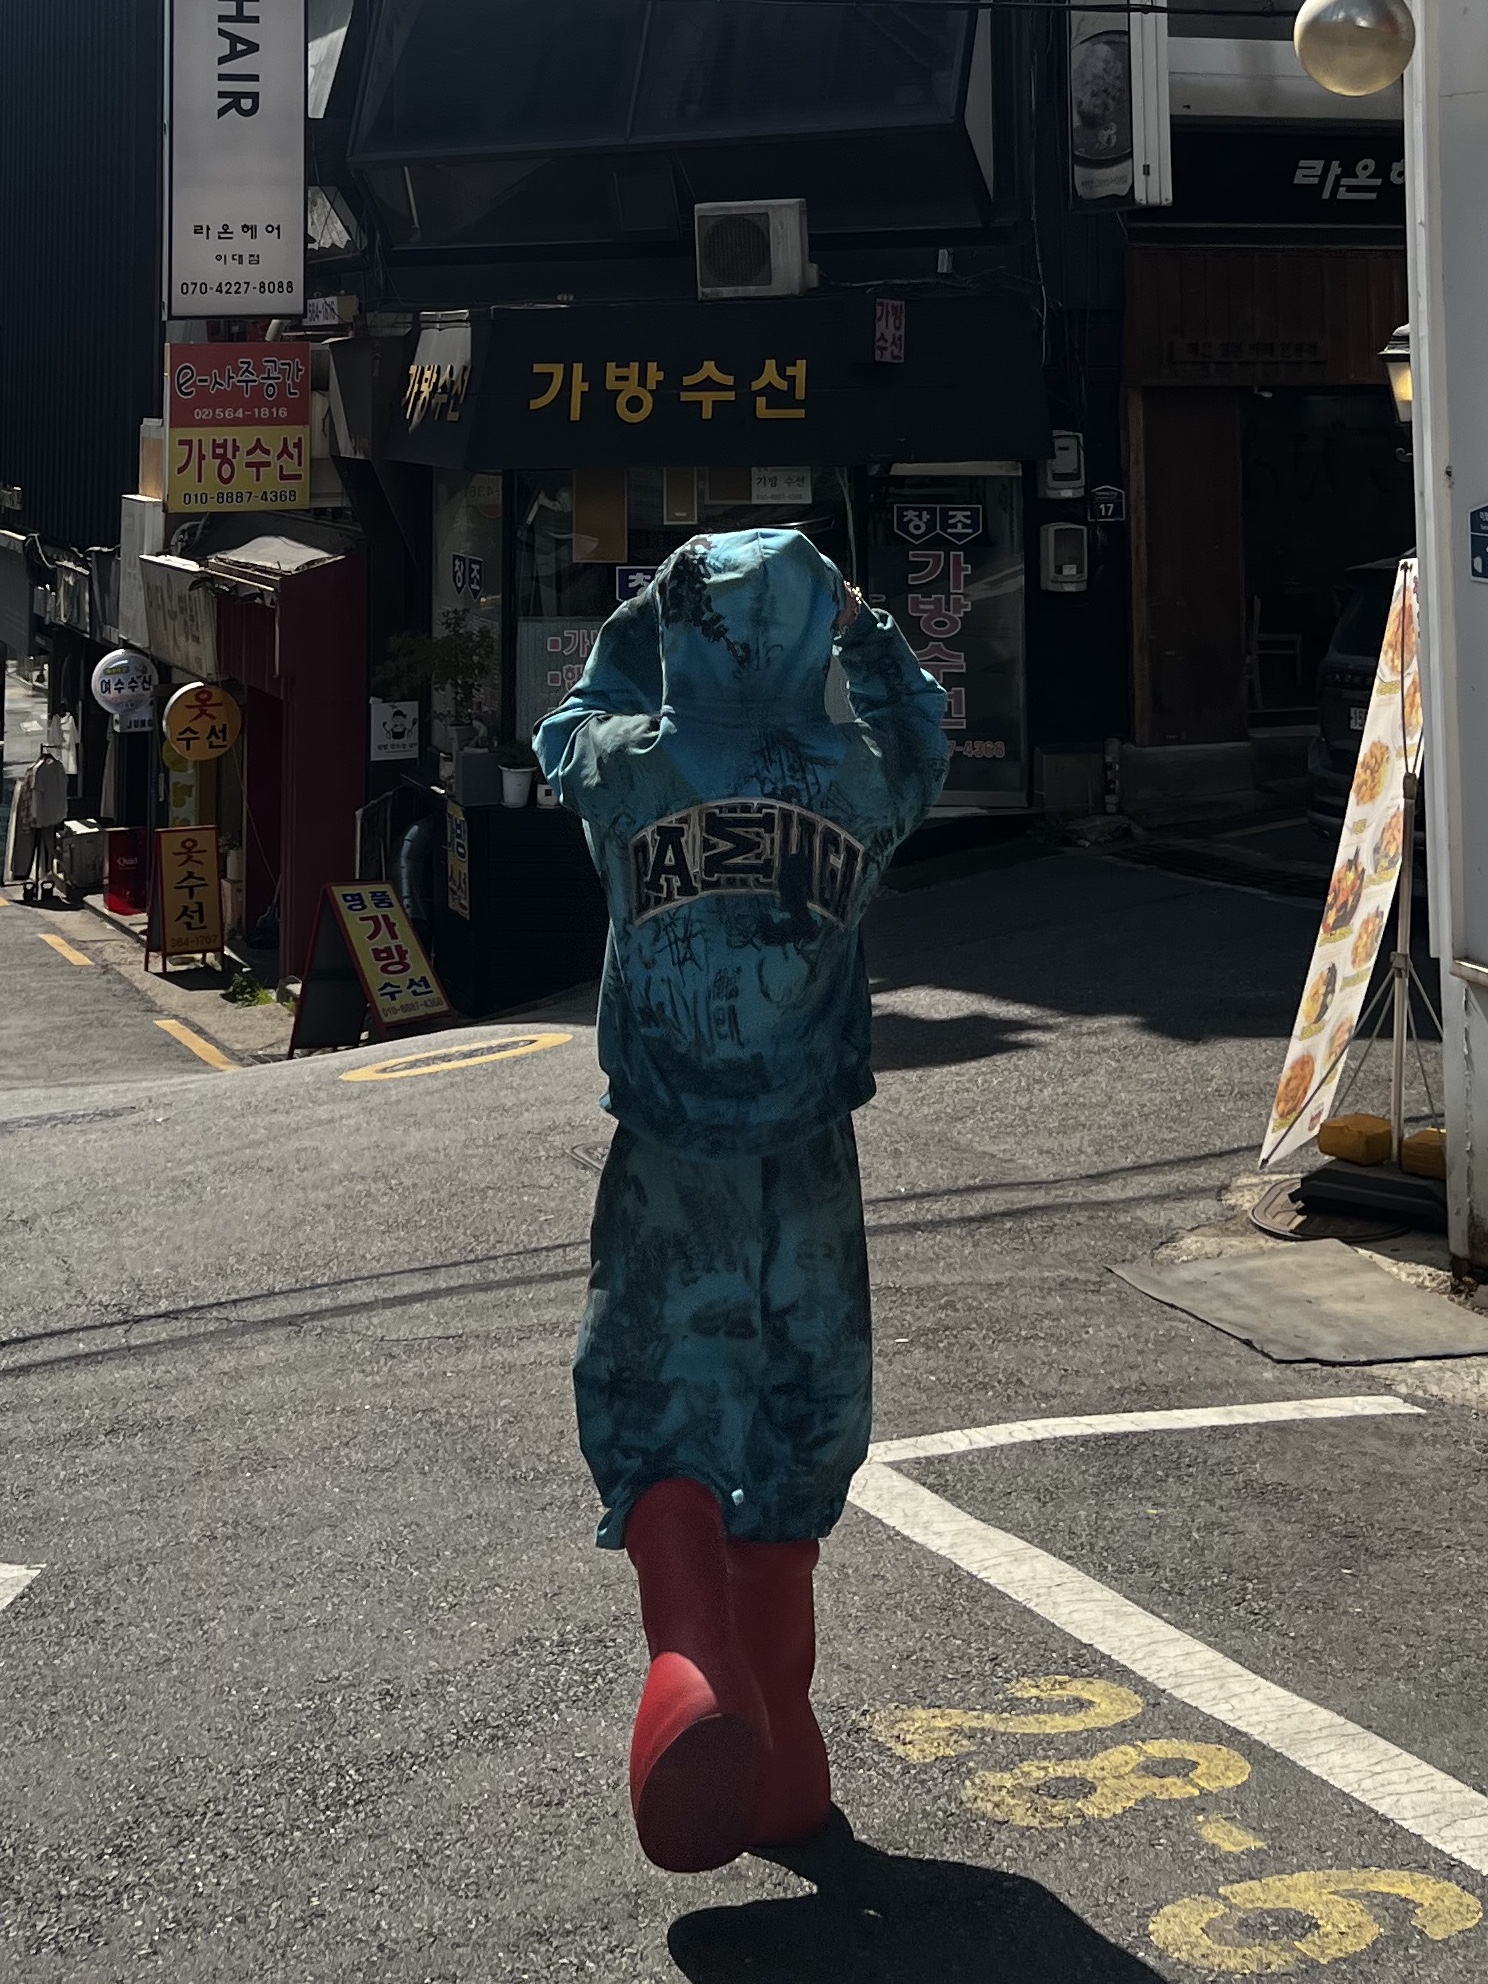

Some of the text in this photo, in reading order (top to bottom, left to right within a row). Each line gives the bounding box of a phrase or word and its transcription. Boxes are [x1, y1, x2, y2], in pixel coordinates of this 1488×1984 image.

[193, 223, 281, 240] 라온헤어
[215, 253, 261, 266] 이대점
[180, 281, 294, 296] 070-4227-8088
[877, 301, 904, 330] 가방
[877, 332, 903, 360] 수선
[401, 363, 470, 434] 가방수선
[528, 358, 808, 424] 가방수선
[176, 436, 305, 485] 가방수선
[183, 490, 297, 505] 010-8887-4368
[1099, 503, 1114, 516] 17
[903, 510, 974, 535] 창조
[185, 688, 223, 722] 옷
[176, 724, 227, 750] 수선
[341, 890, 394, 911] 명품
[378, 976, 433, 1001] 수선
